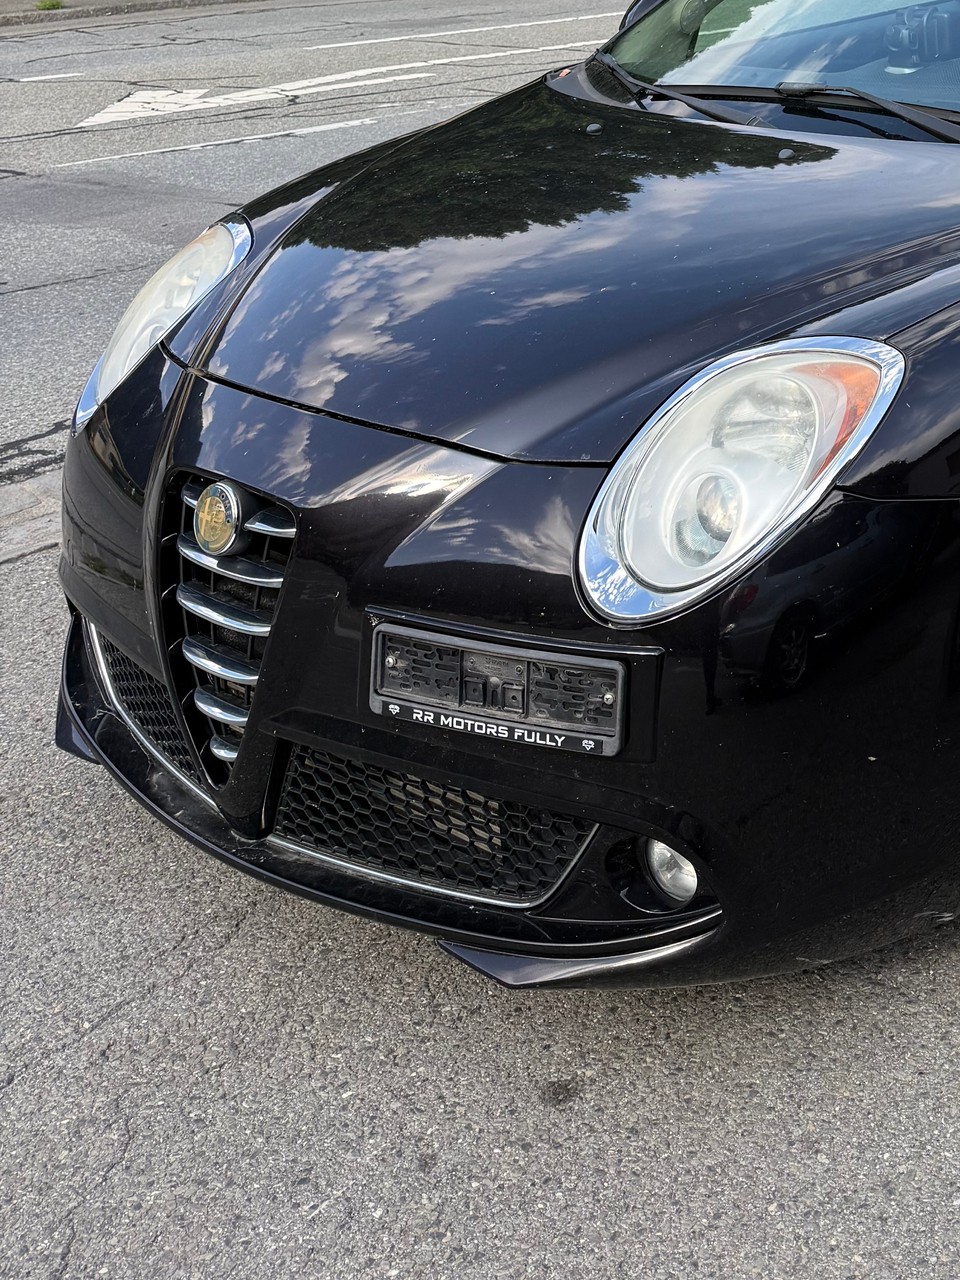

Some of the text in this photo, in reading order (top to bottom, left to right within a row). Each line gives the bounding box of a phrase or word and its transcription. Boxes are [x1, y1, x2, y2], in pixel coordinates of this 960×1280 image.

[412, 709, 435, 724] RR
[440, 714, 509, 738] MOTORS
[514, 729, 566, 747] FULLY
